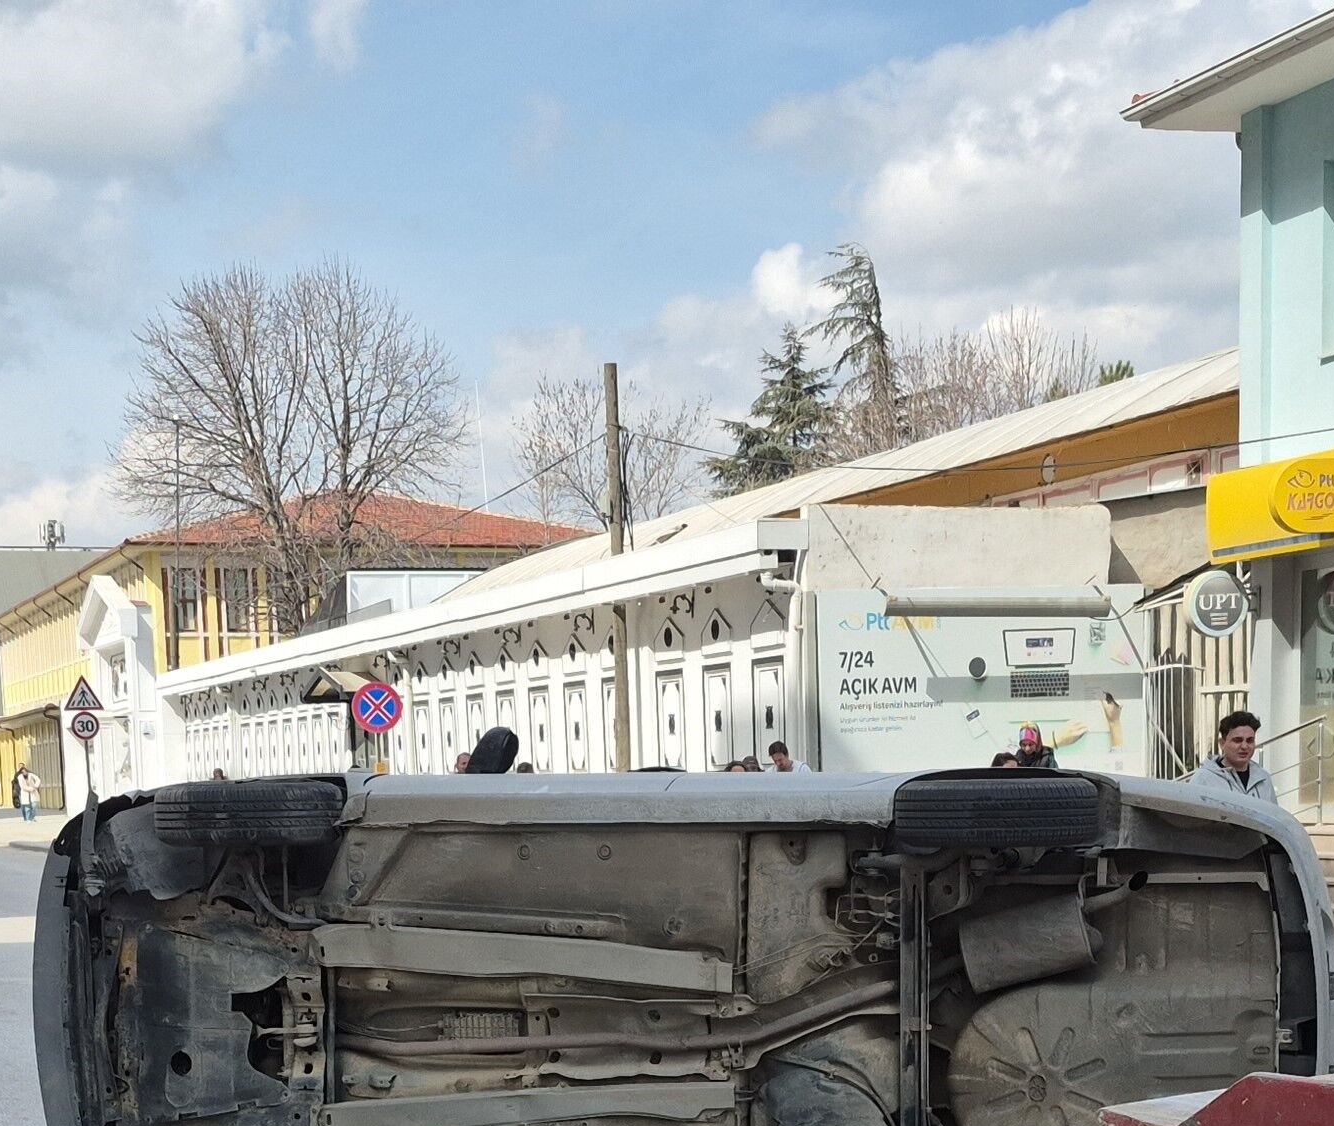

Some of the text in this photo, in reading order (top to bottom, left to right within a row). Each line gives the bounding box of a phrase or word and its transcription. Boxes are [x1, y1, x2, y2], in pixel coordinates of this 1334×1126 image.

[1198, 592, 1241, 611] UPT
[839, 651, 874, 673] 7/24
[839, 677, 917, 700] AÇIK AVM
[839, 702, 872, 712] Alışveriş
[873, 700, 903, 710] listenizi
[77, 720, 95, 733] 30
